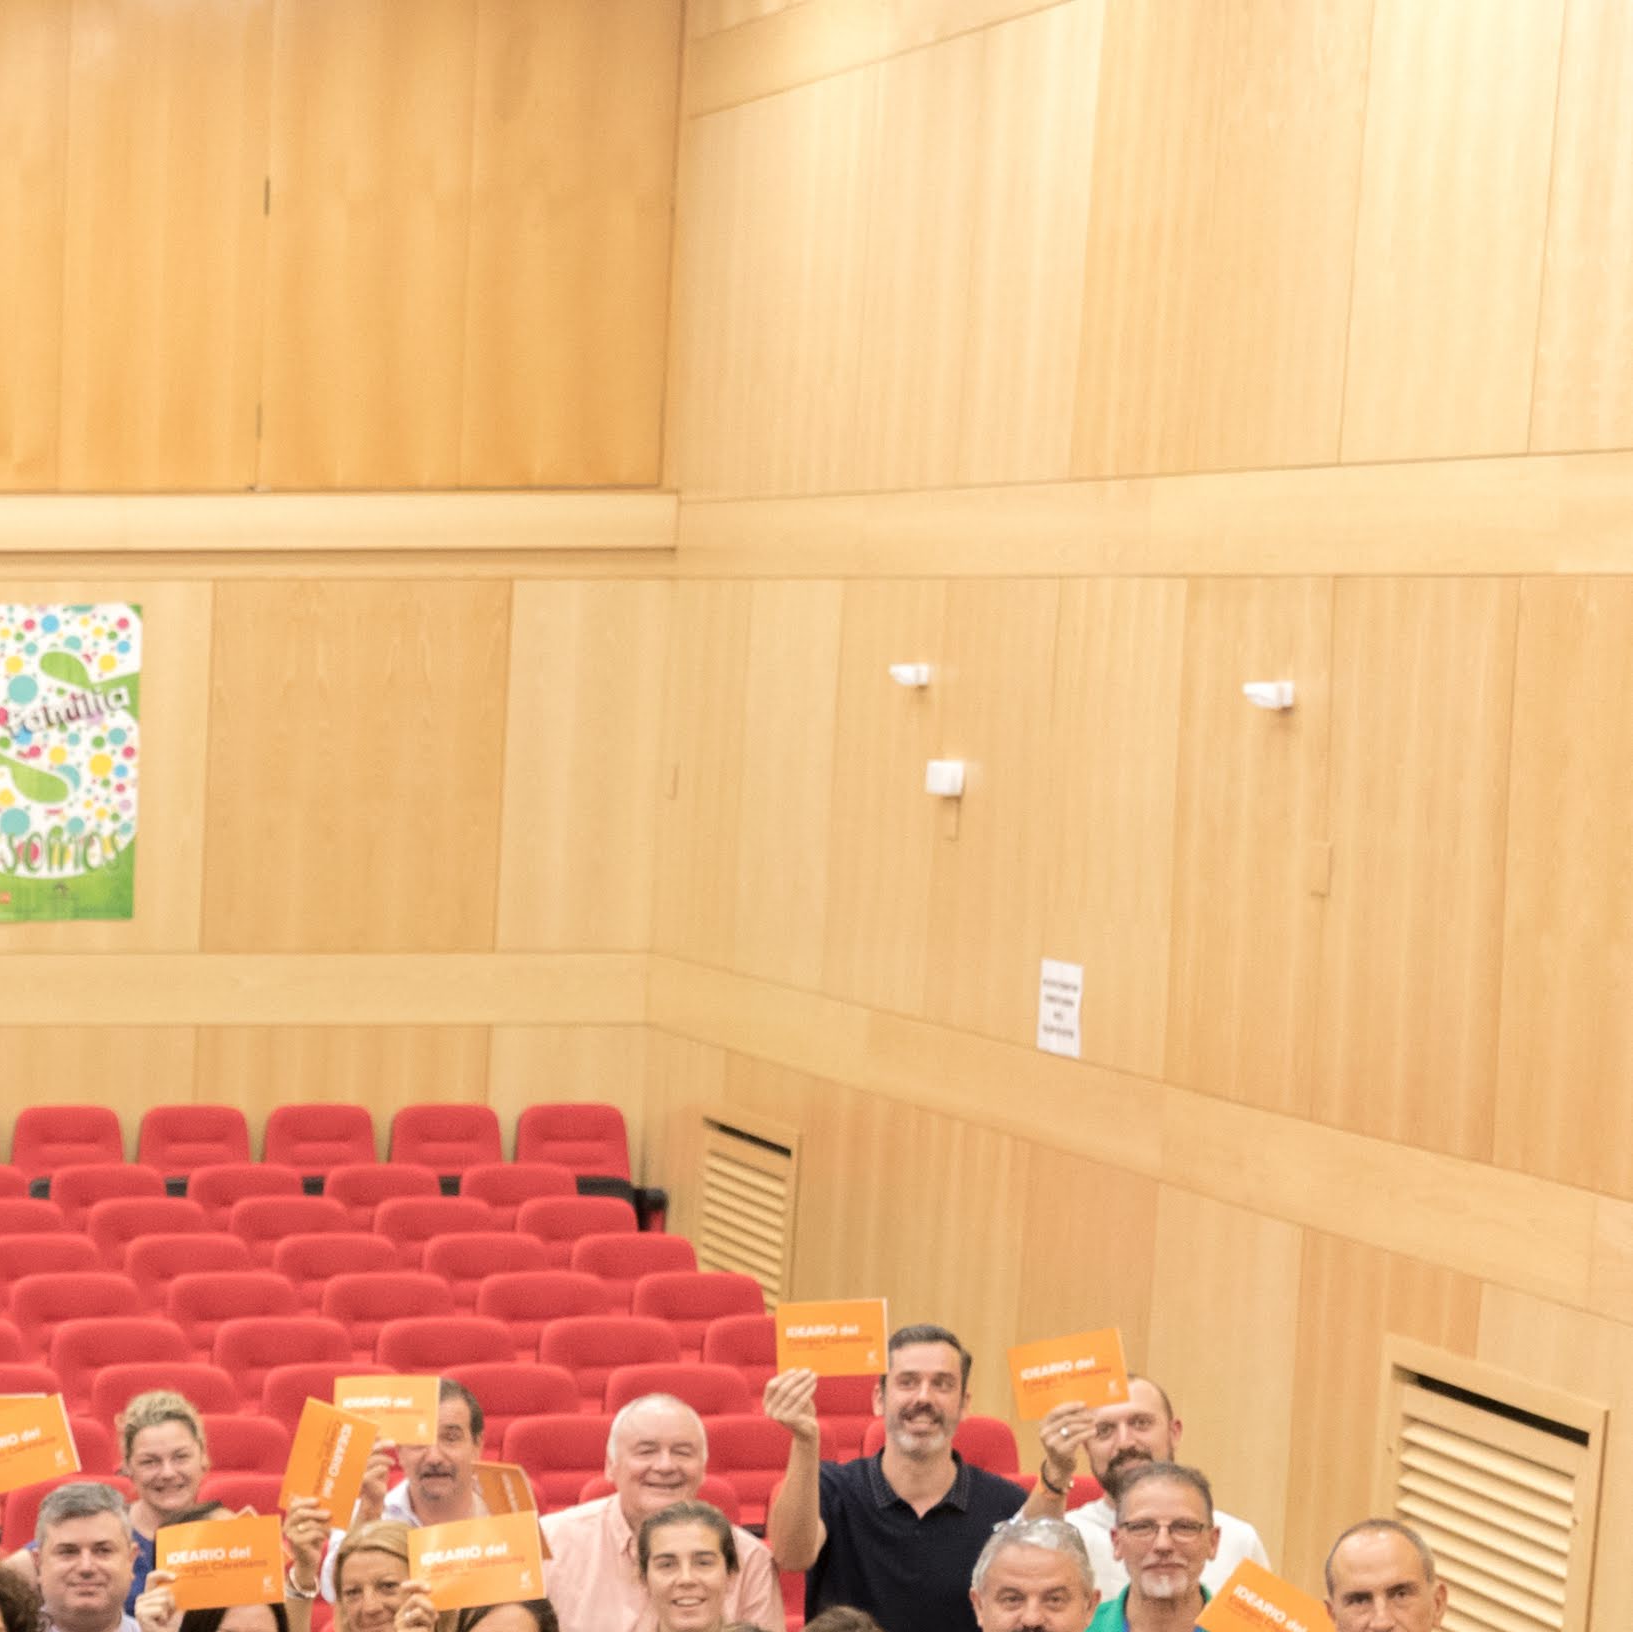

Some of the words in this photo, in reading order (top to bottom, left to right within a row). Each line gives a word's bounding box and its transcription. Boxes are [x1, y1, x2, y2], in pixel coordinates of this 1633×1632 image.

[786, 1325, 837, 1337] IDEARIO
[839, 1323, 858, 1335] del
[1232, 1584, 1285, 1622] IDEARIO
